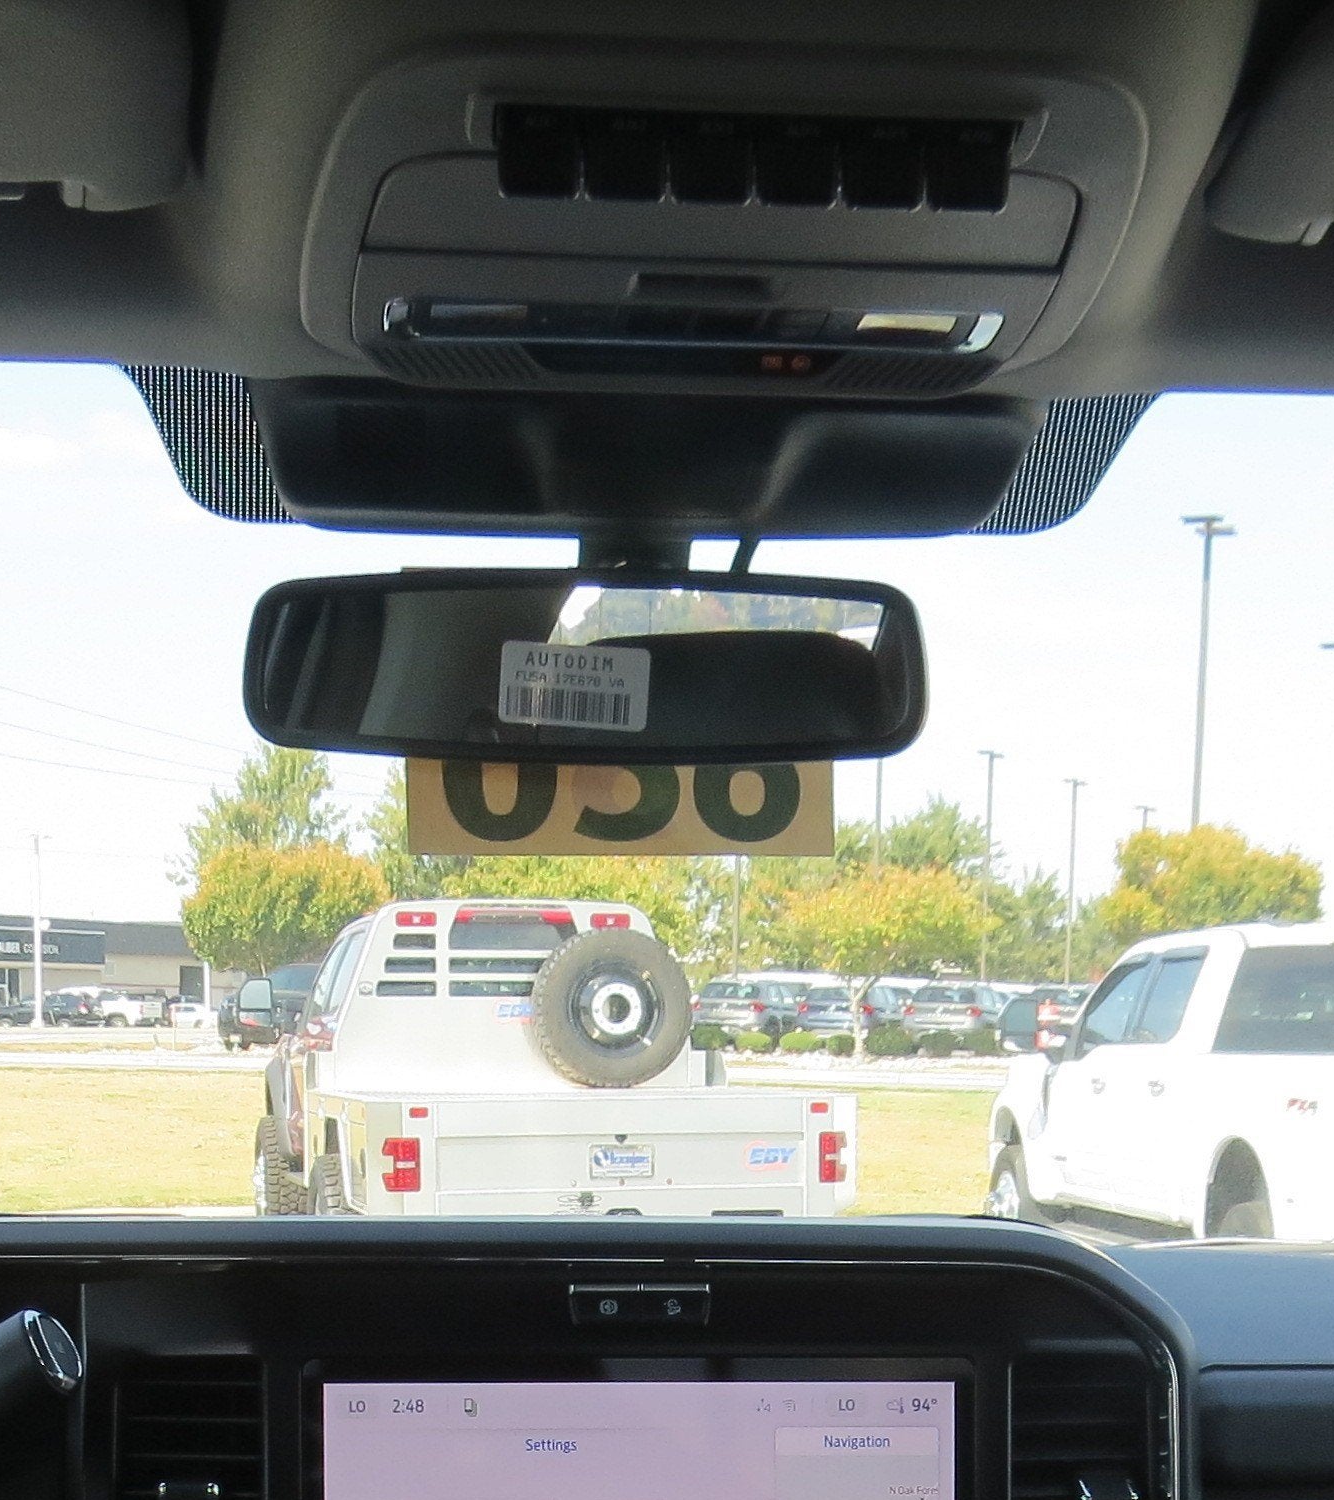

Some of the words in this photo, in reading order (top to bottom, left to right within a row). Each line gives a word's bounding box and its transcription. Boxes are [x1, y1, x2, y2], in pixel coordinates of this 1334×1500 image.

[525, 651, 614, 672] AUTODIM
[23, 943, 60, 955] COSION
[498, 1004, 535, 1017] EB
[348, 1399, 366, 1413] LO
[392, 1399, 425, 1413] 2:48
[838, 1399, 855, 1412] LO
[525, 1438, 578, 1453] Settings
[824, 1435, 891, 1450] Navigation
[897, 1486, 914, 1495] Oak
